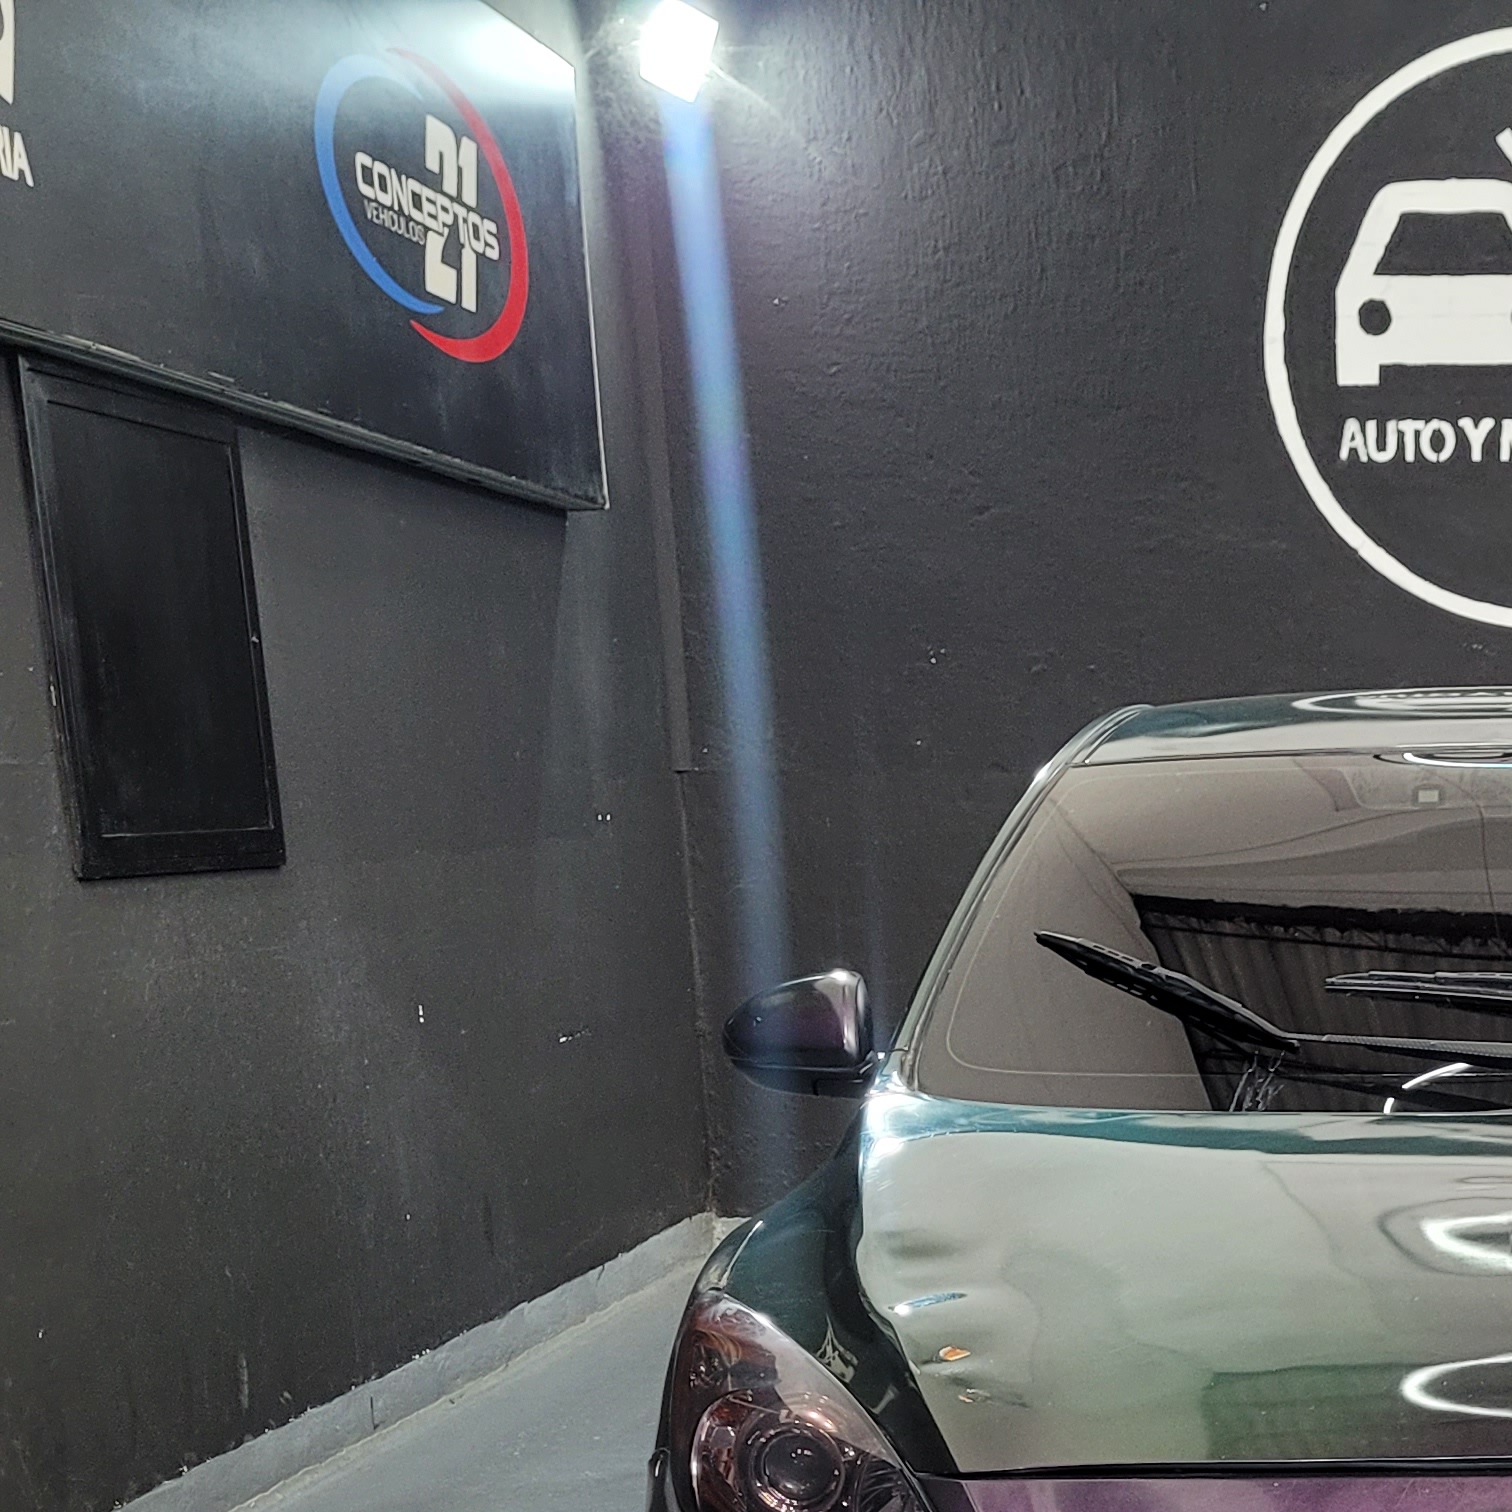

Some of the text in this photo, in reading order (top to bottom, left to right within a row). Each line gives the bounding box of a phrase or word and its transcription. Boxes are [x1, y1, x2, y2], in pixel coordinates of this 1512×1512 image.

[355, 151, 500, 261] CONCEPTOS
[1339, 417, 1456, 463] AUTO
[1457, 416, 1496, 463] Y
